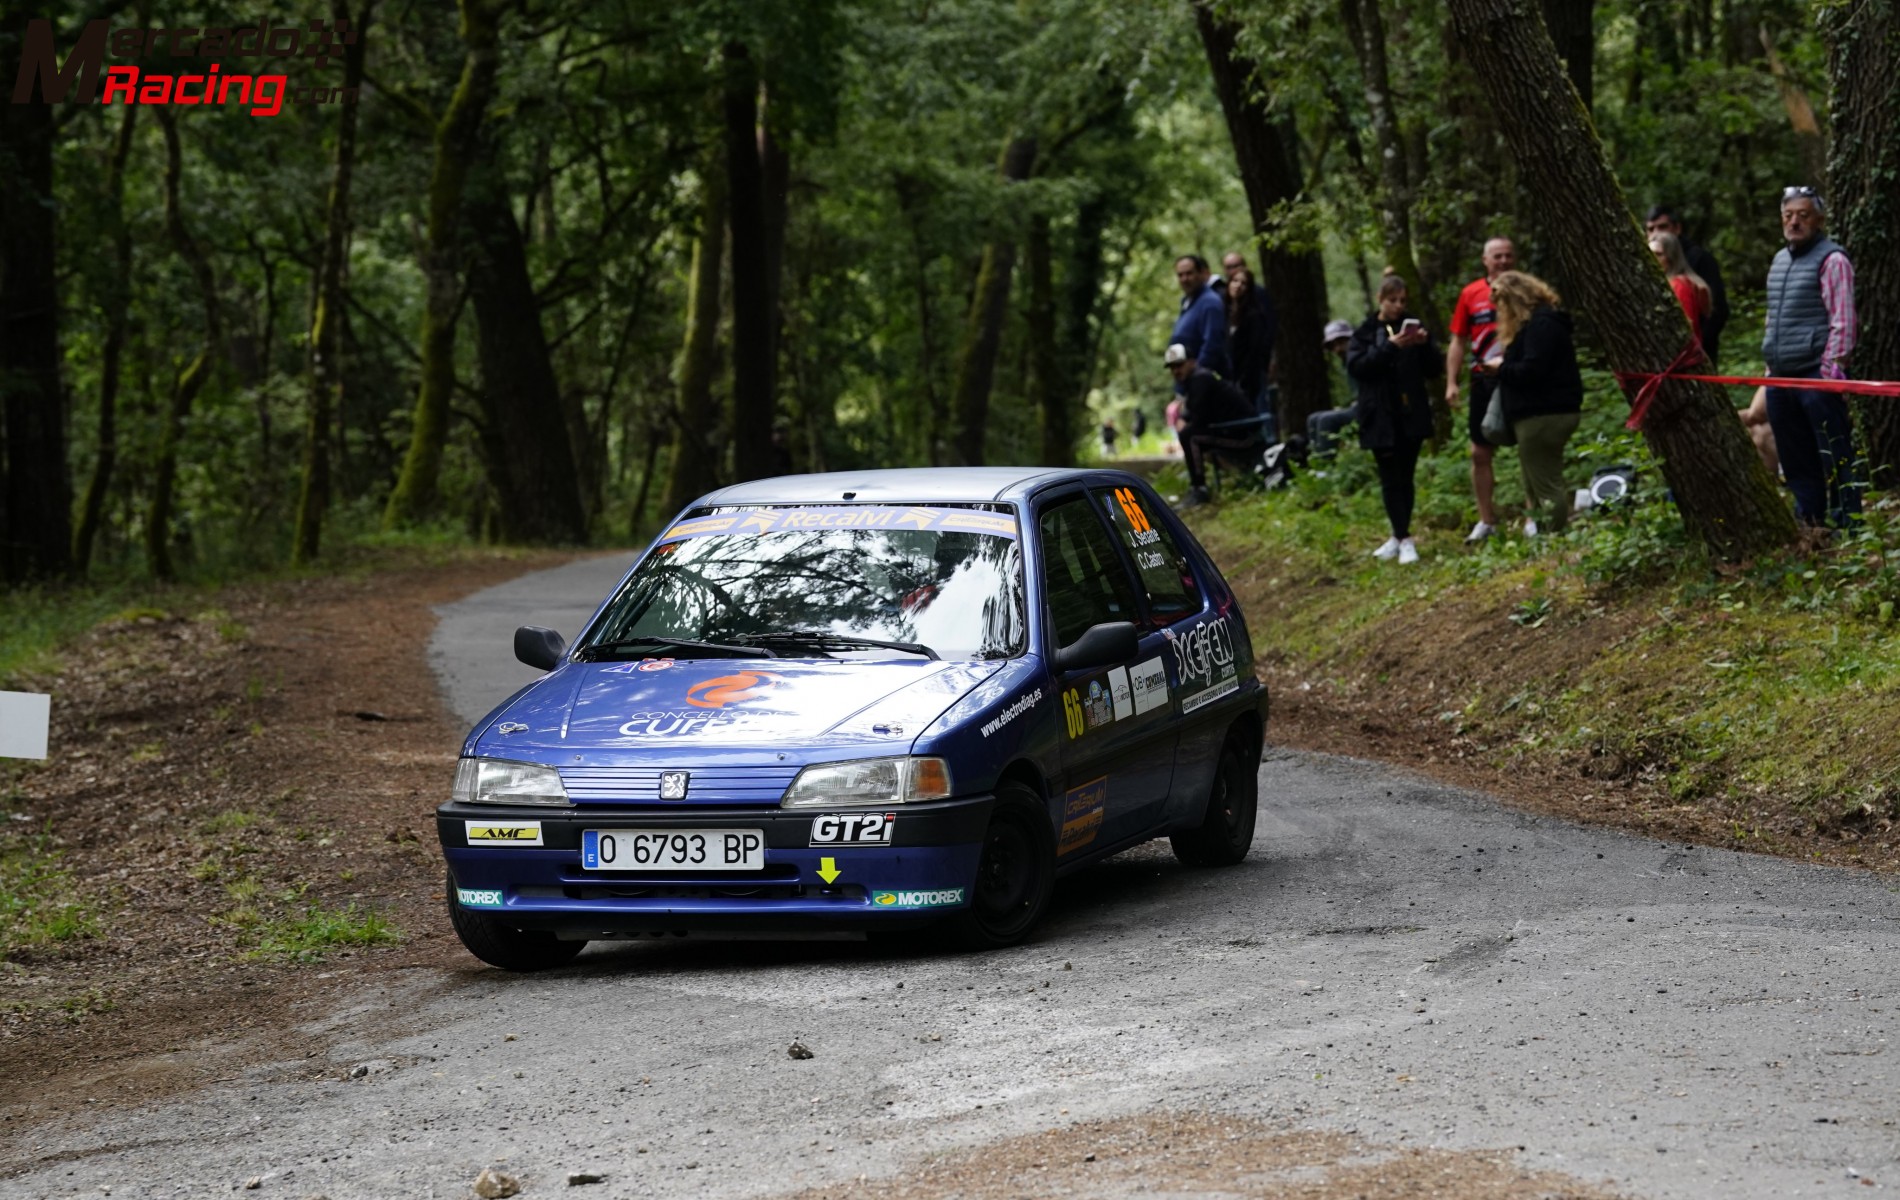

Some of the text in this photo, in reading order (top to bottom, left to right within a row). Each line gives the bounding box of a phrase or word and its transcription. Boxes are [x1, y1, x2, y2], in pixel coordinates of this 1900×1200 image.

[782, 510, 896, 528] Recalvi
[1115, 488, 1150, 532] 66
[632, 710, 748, 720] CONCELLO
[980, 687, 1042, 738] www.electrodiag.es
[1063, 688, 1084, 740] 66
[481, 828, 526, 838] AMF
[813, 814, 895, 842] GT2i
[588, 853, 595, 862] E
[633, 834, 706, 864] 6793
[723, 834, 760, 864] BP
[898, 889, 963, 905] MOTOREX
